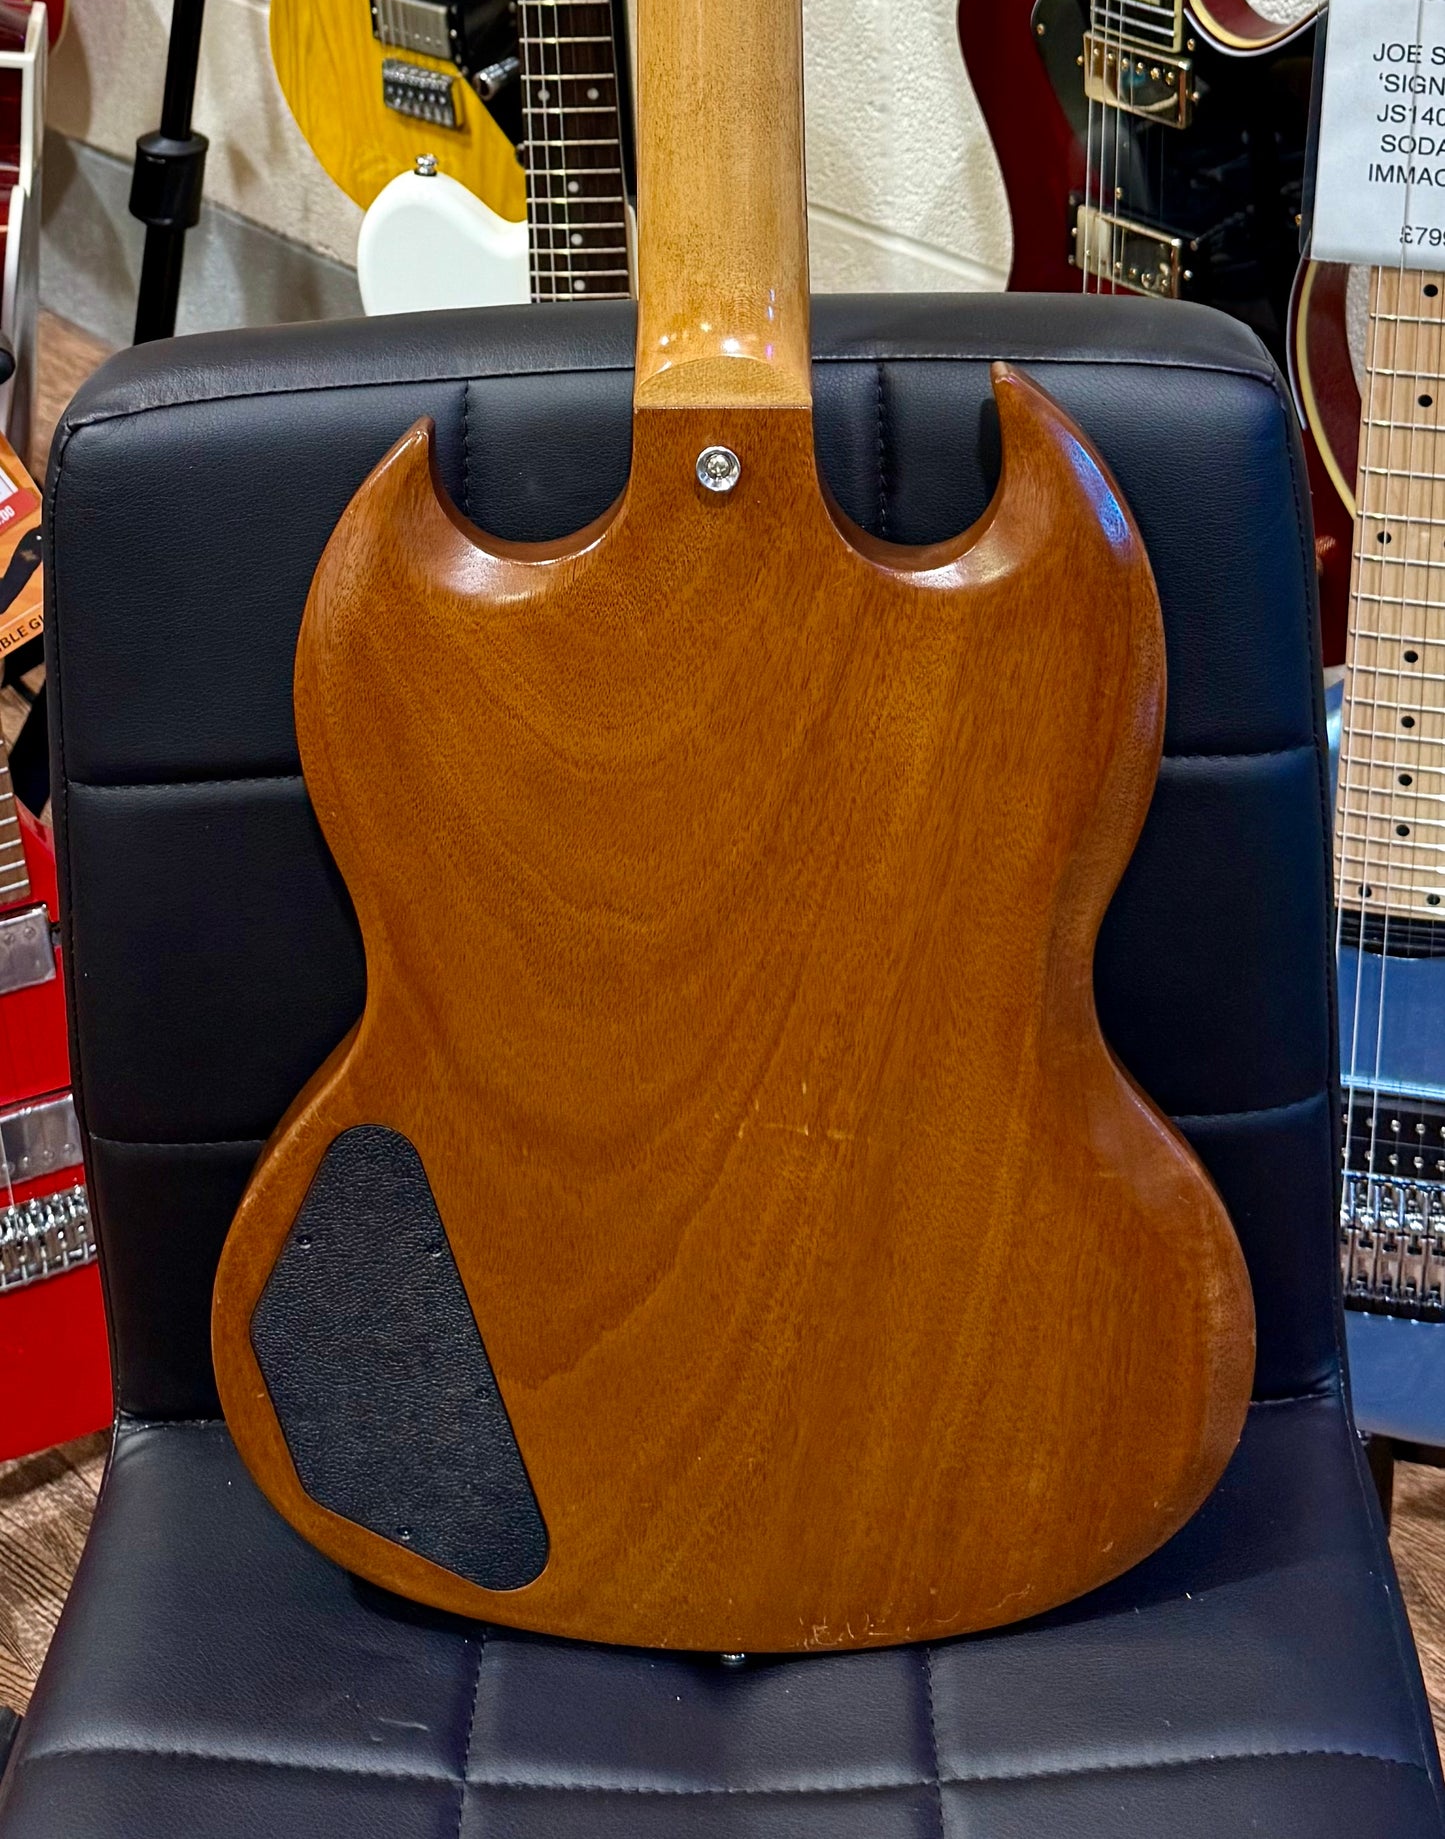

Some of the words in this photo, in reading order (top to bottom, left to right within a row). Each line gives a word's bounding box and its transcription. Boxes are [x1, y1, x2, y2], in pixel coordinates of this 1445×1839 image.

[1373, 43, 1422, 64] JOE
[1399, 225, 1445, 247] £79
[0, 625, 29, 652] BLE
